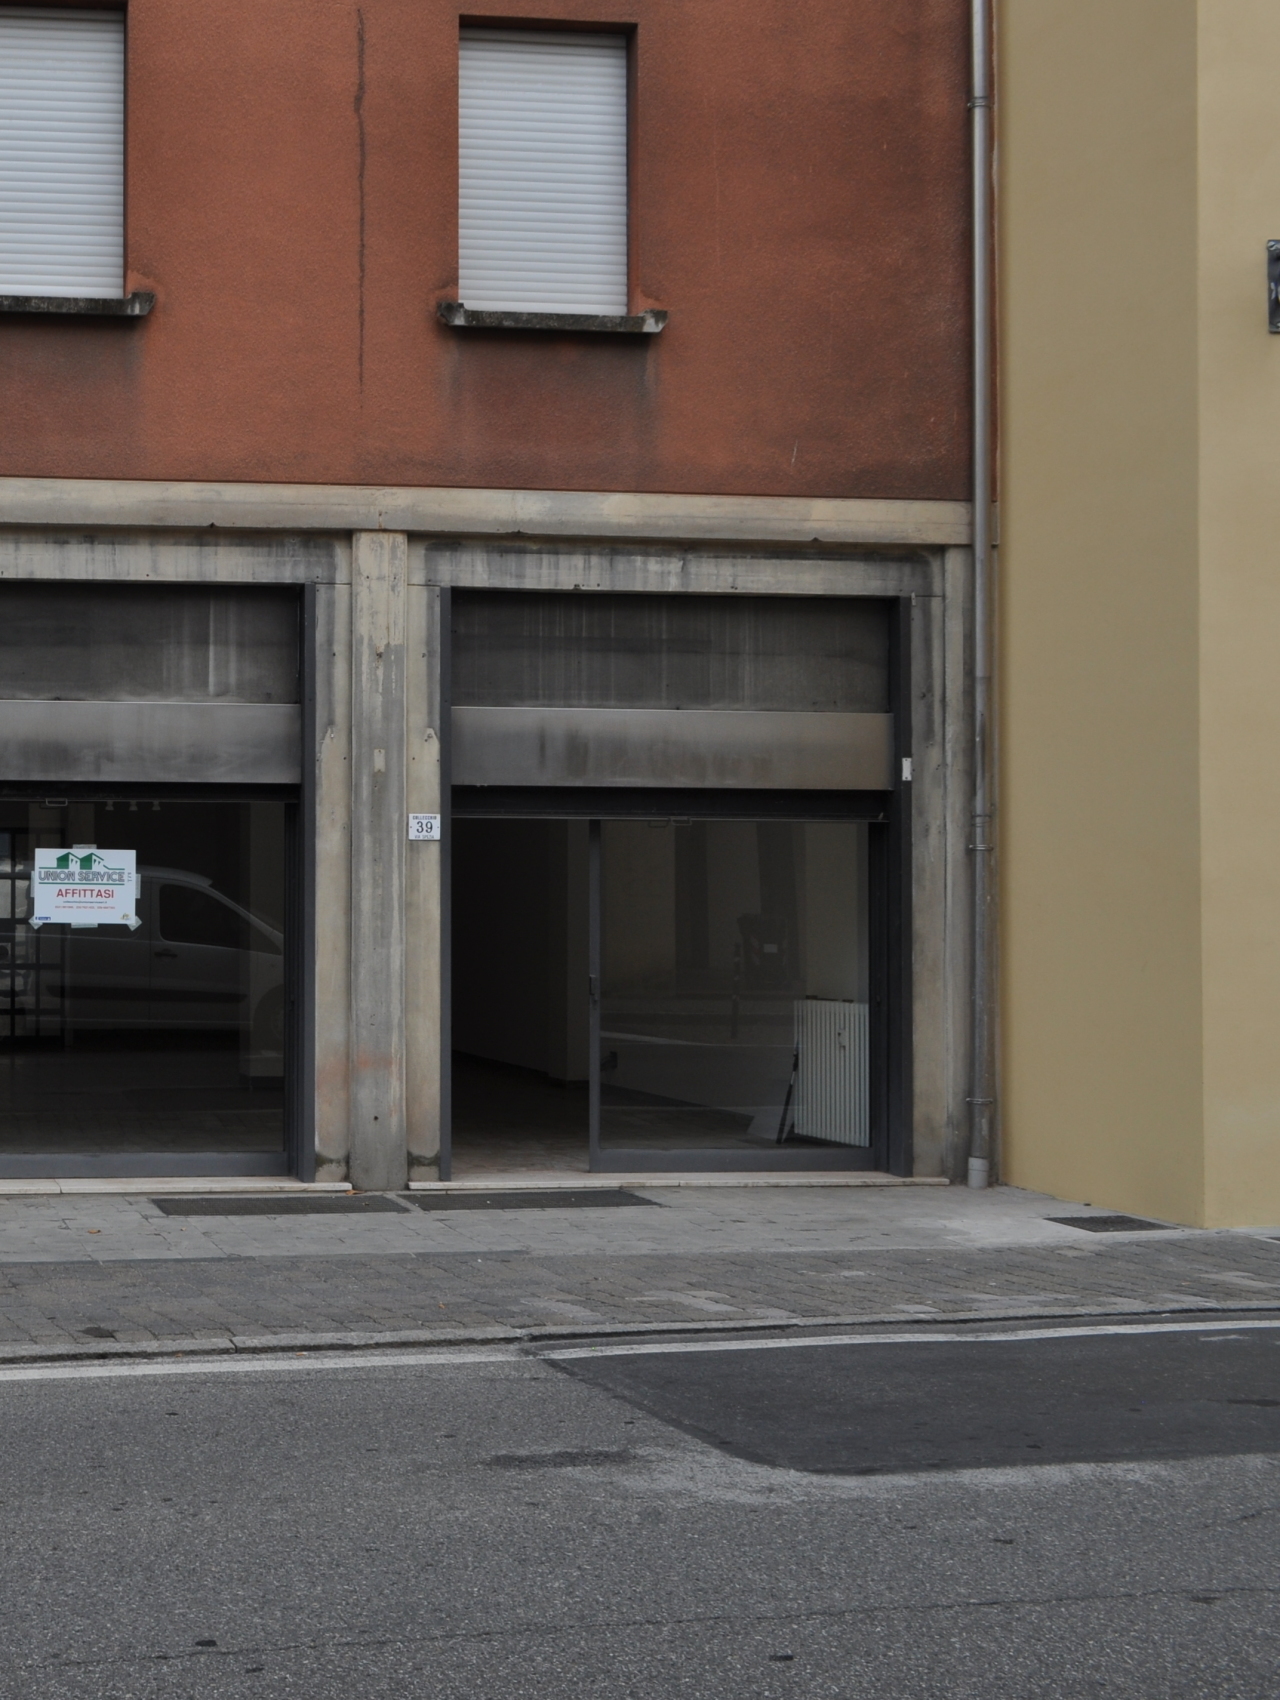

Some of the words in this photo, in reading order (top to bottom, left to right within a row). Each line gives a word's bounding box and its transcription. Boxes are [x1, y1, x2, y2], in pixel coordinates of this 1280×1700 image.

[416, 820, 433, 833] 39
[38, 870, 75, 882] UNION
[78, 871, 125, 883] SERVICE
[57, 888, 114, 899] AFFITTASI
